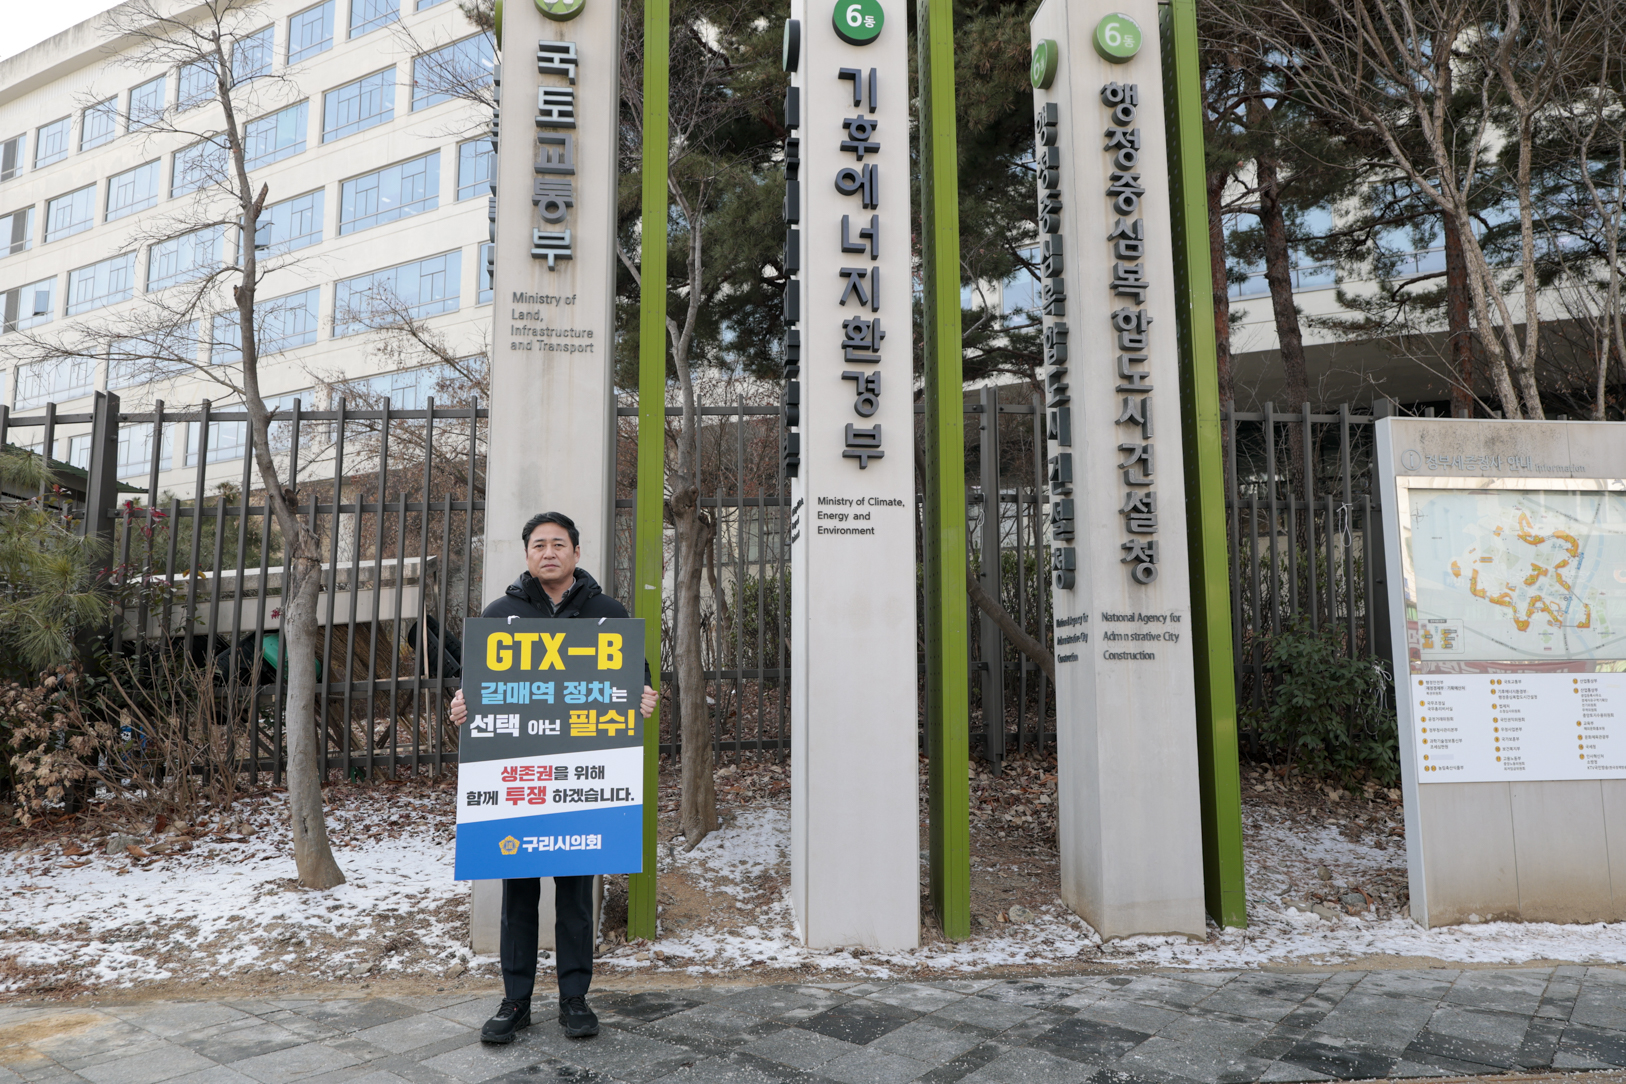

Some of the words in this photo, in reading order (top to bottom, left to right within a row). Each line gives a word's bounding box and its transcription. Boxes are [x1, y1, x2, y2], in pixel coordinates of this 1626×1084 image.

[845, 4, 876, 29] 6동
[1104, 22, 1136, 48] 6동
[531, 39, 579, 271] 국토교통부
[834, 67, 886, 469] 기후에너지환경부
[512, 291, 561, 307] Ministry
[565, 294, 577, 305] of
[511, 308, 544, 322] Land,
[511, 324, 594, 338] Infrastructure
[1100, 81, 1159, 585] 행정중심복합도시건설청
[510, 339, 532, 351] and
[536, 339, 594, 355] Transport
[1425, 454, 1502, 472] 정부세종청사
[1507, 455, 1533, 472] 안내
[817, 496, 853, 507] Ministry
[855, 496, 865, 506] of
[867, 497, 905, 508] Climate,
[817, 511, 849, 522] Energy
[852, 511, 871, 520] and
[817, 525, 875, 535] Environment
[1101, 611, 1135, 622] National
[1137, 612, 1167, 625] Agency
[1169, 612, 1182, 622] for
[1162, 631, 1180, 644] City
[486, 631, 623, 672] GTX-B
[1103, 649, 1156, 660] Construction
[480, 681, 555, 705] 갈매역
[563, 681, 628, 704] 정차는
[469, 713, 520, 738] 선택
[527, 719, 561, 736] 아닌
[568, 709, 635, 737] 필수!
[500, 765, 569, 783] 생존권을
[574, 765, 605, 781] 위해
[466, 790, 499, 806] 함께
[505, 785, 547, 806] 투쟁
[552, 786, 635, 804] 하겠습니다.
[522, 834, 602, 852] 구리시의회
